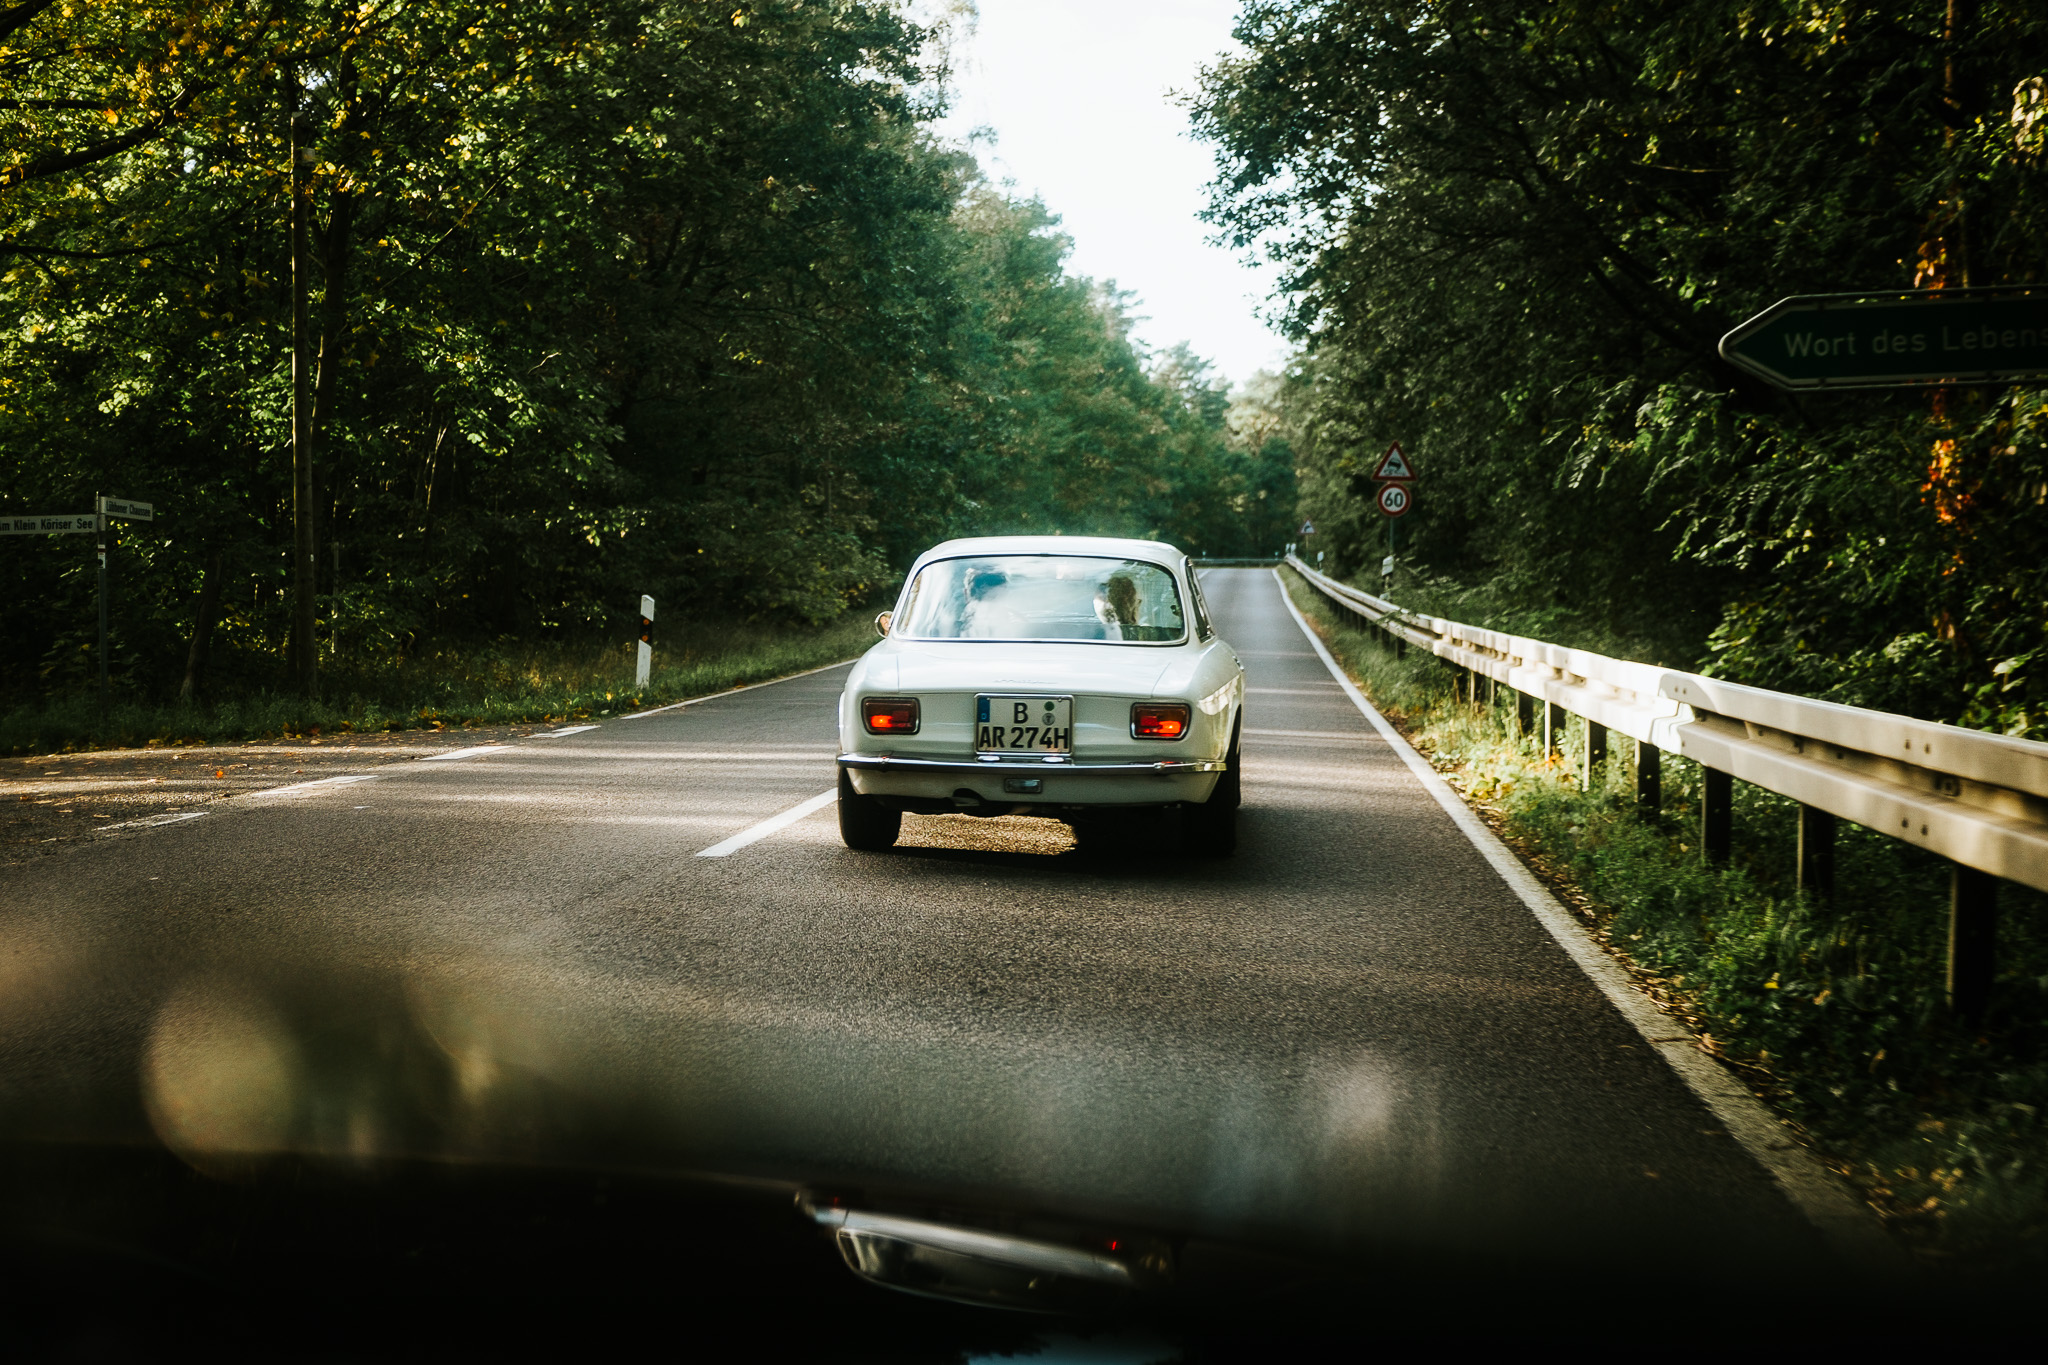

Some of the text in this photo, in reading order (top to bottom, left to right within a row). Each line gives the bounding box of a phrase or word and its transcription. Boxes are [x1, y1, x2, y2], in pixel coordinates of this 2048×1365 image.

[1784, 331, 1857, 358] Wort
[1872, 328, 1927, 355] des
[1384, 492, 1404, 508] 60
[0, 517, 93, 531] m Klein Köriser See
[1013, 702, 1029, 724] B
[980, 726, 1069, 749] AR 274H
